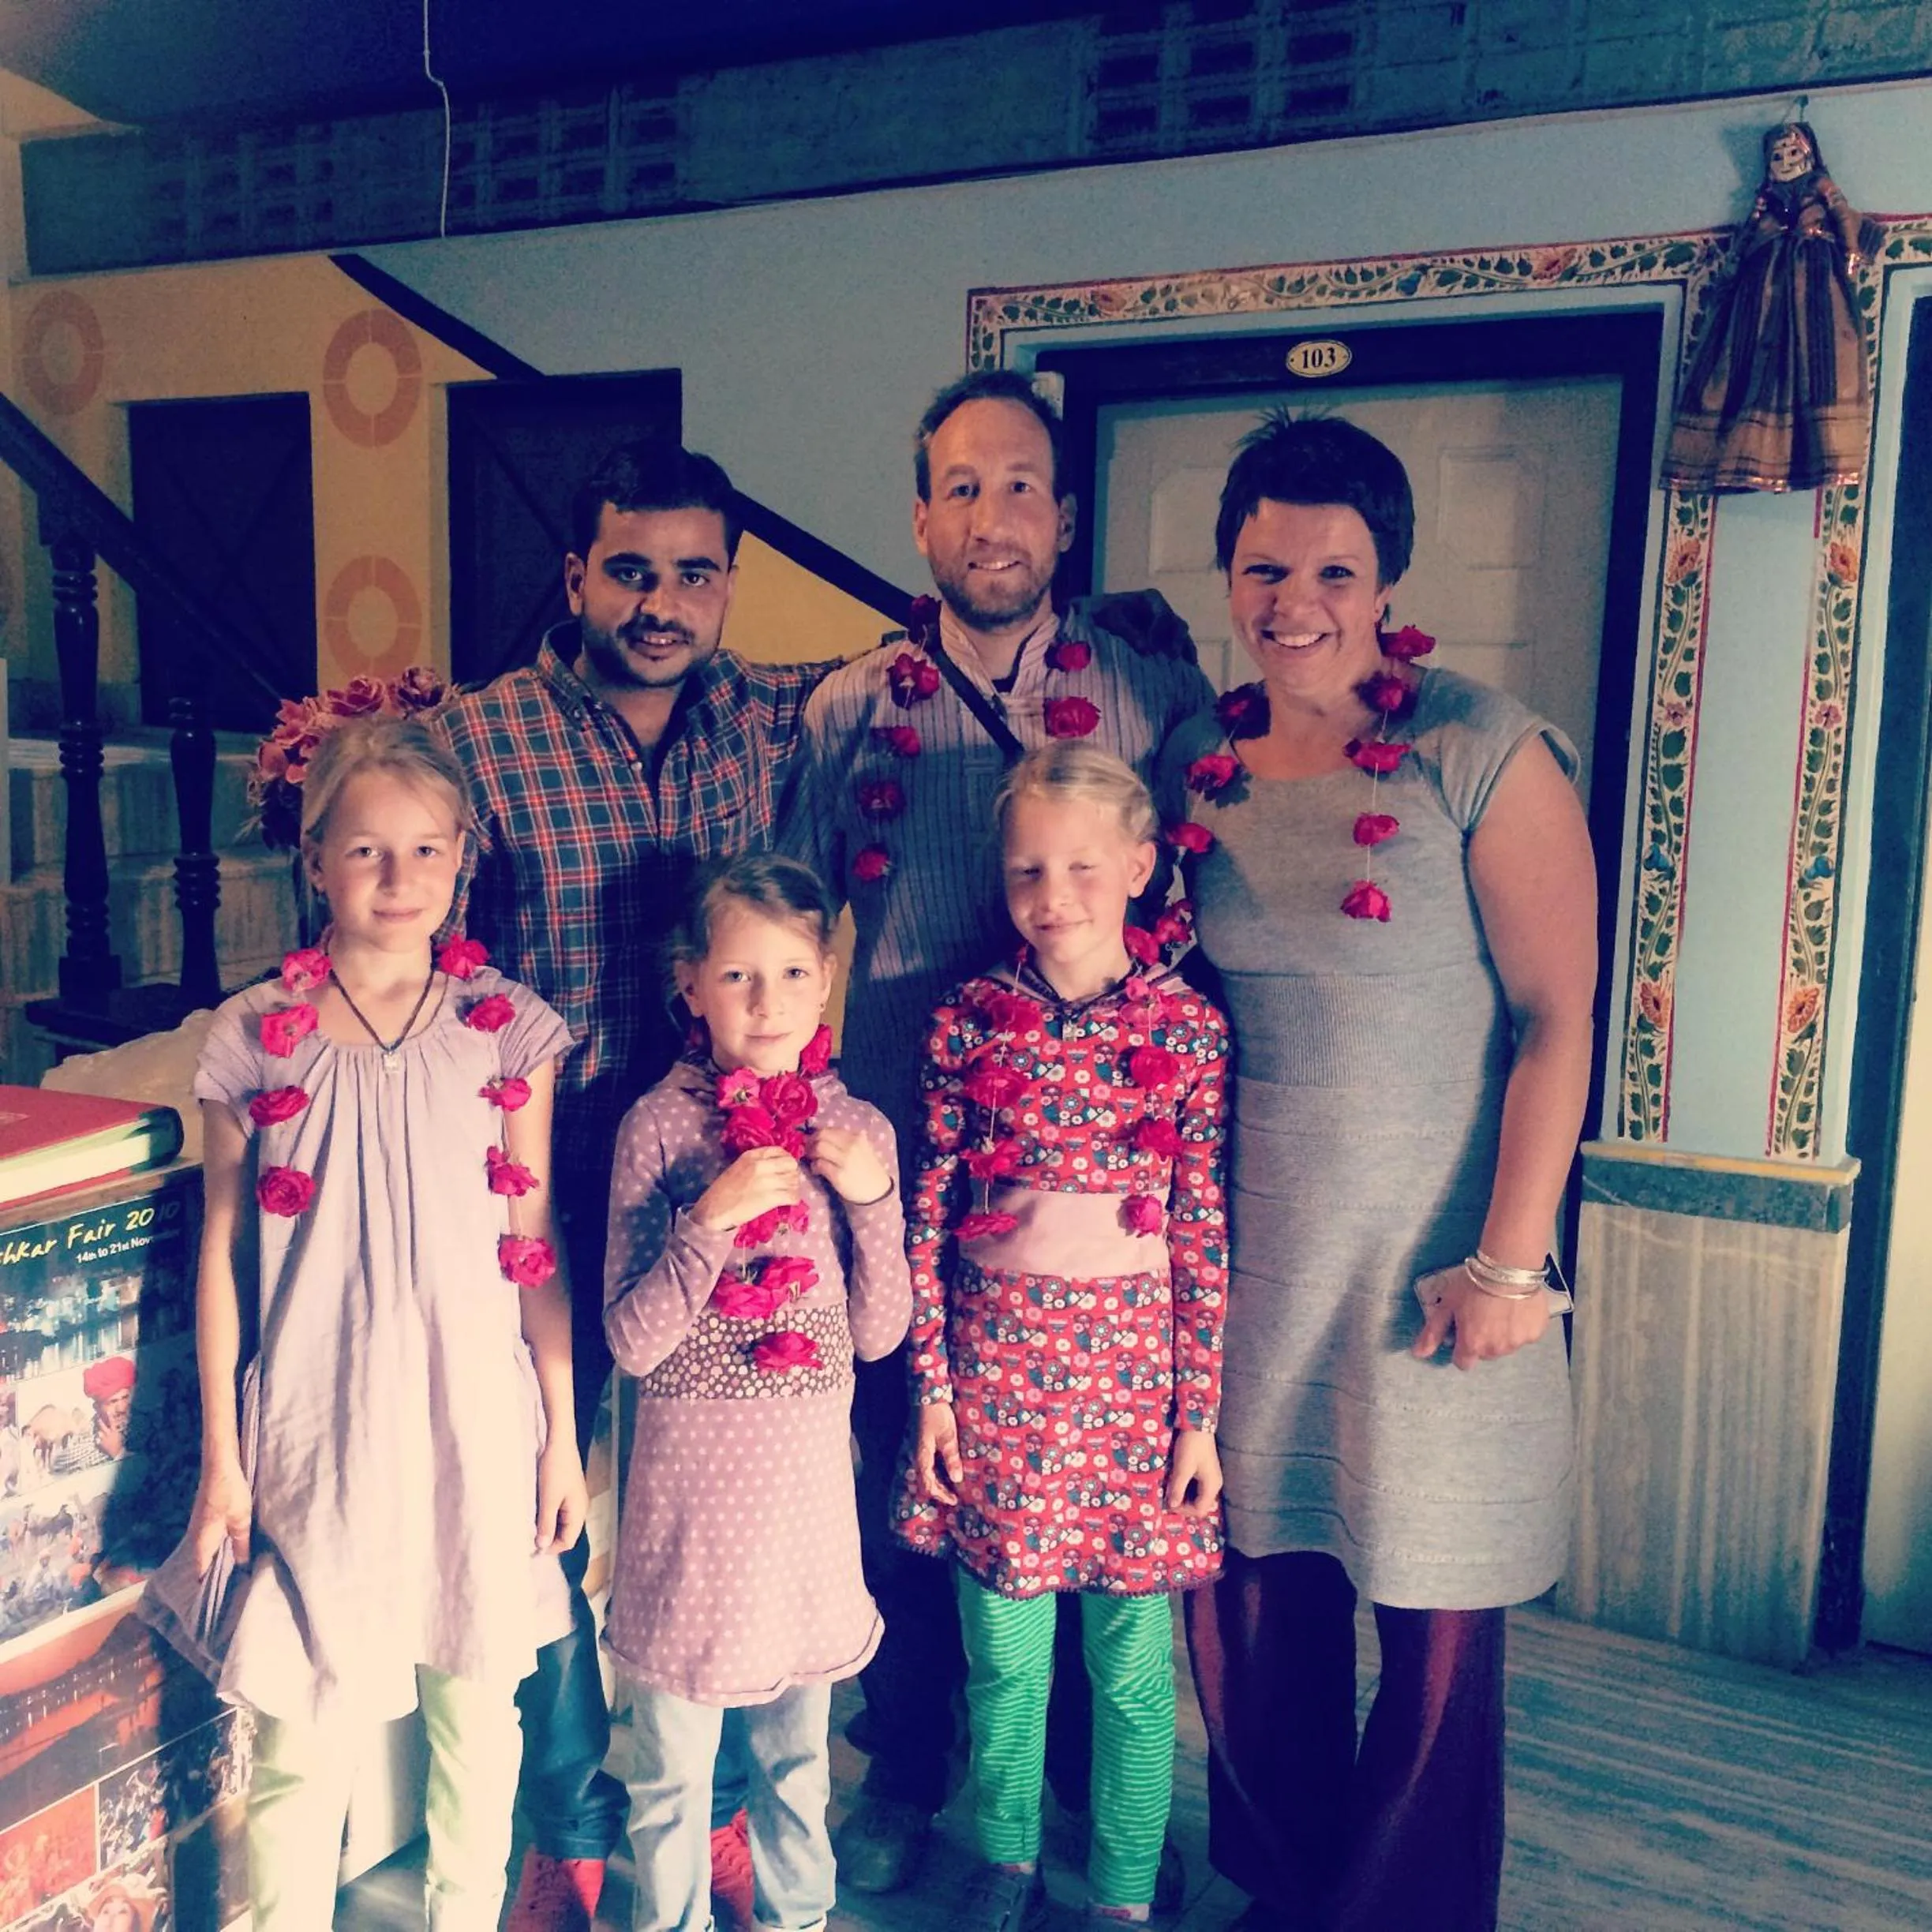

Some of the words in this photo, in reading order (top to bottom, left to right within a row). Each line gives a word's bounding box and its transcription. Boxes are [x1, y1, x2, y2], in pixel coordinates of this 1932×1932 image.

[1302, 346, 1336, 369] 103
[67, 1219, 116, 1249] Fair
[97, 1247, 108, 1258] to
